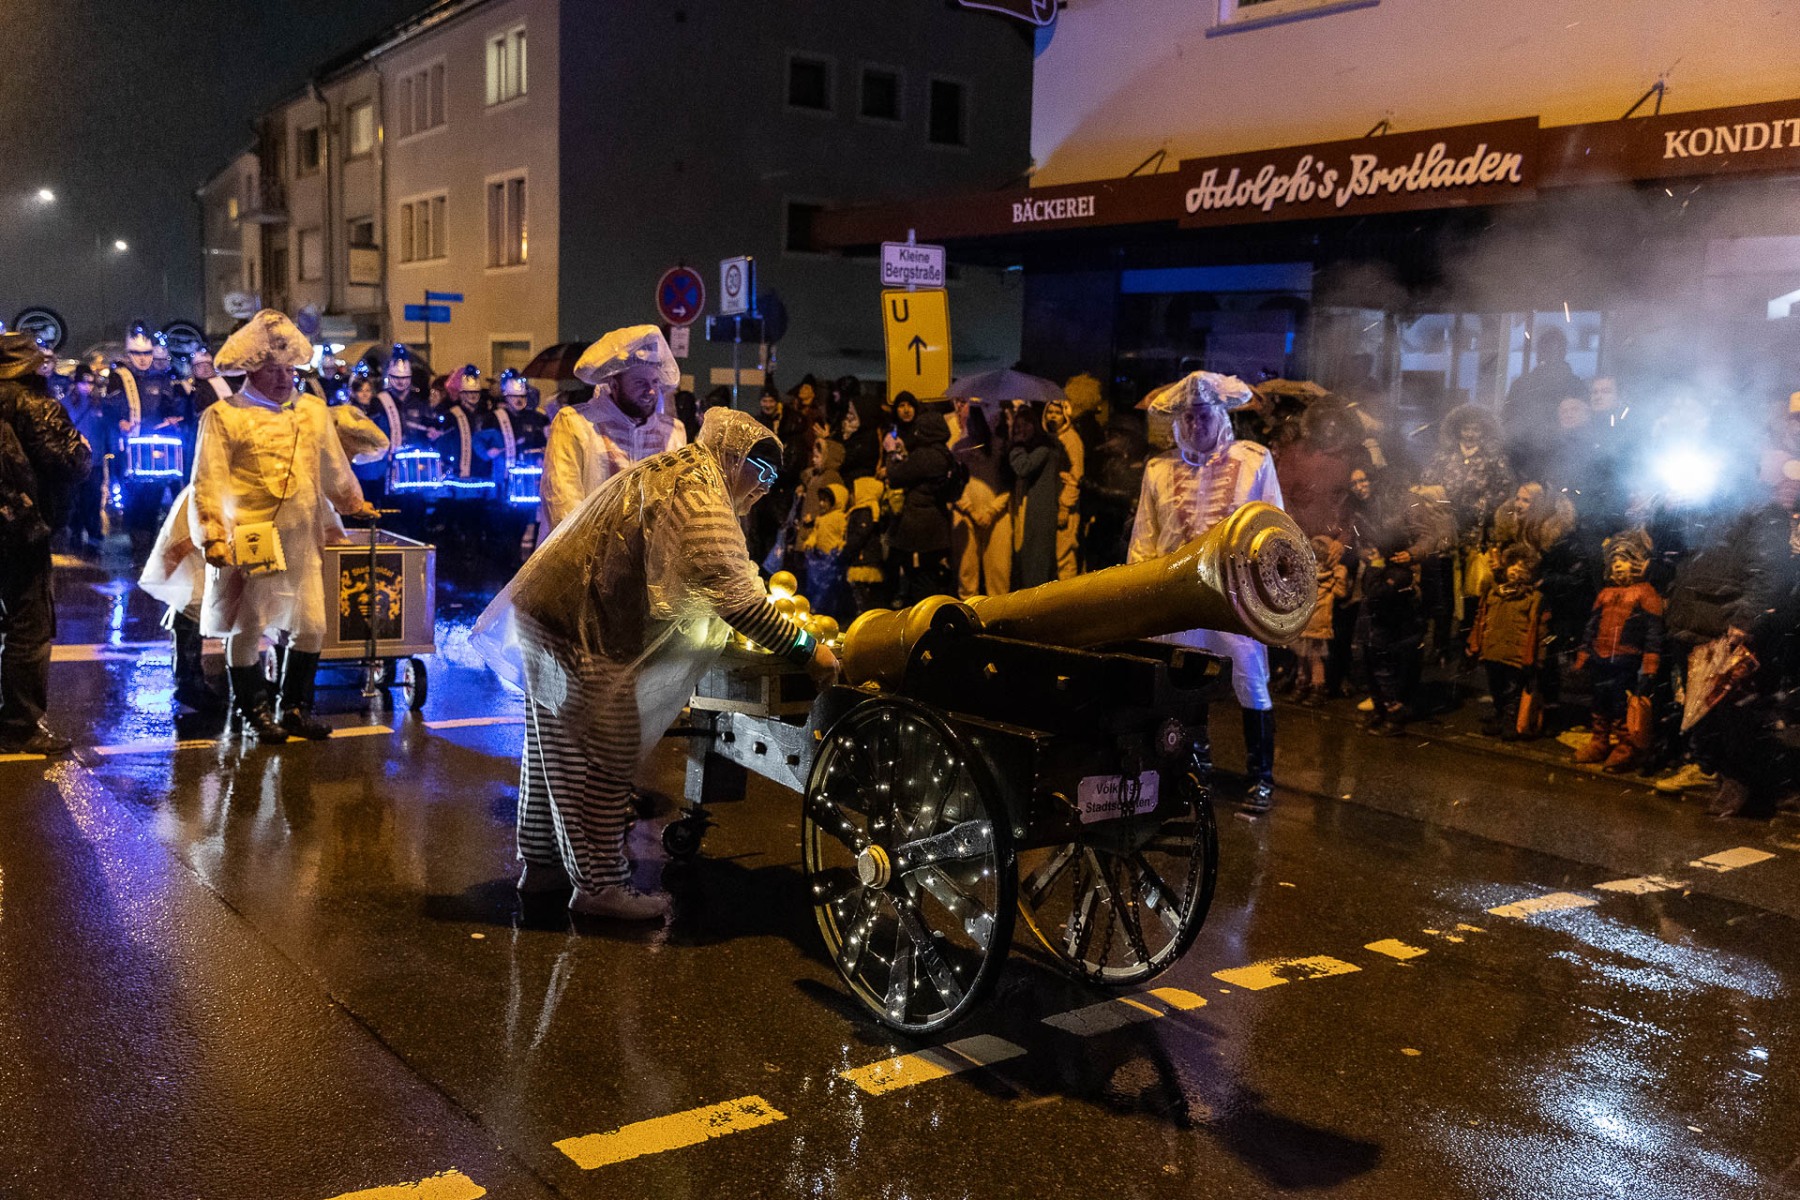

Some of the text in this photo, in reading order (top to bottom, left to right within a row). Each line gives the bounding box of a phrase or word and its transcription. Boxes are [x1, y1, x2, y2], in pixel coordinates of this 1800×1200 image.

[1185, 142, 1523, 213] Adolph's Brotladen
[1012, 196, 1095, 223] BÄCKEREI
[899, 249, 930, 263] Kleine
[885, 262, 941, 282] Bergstraße
[892, 299, 909, 322] U
